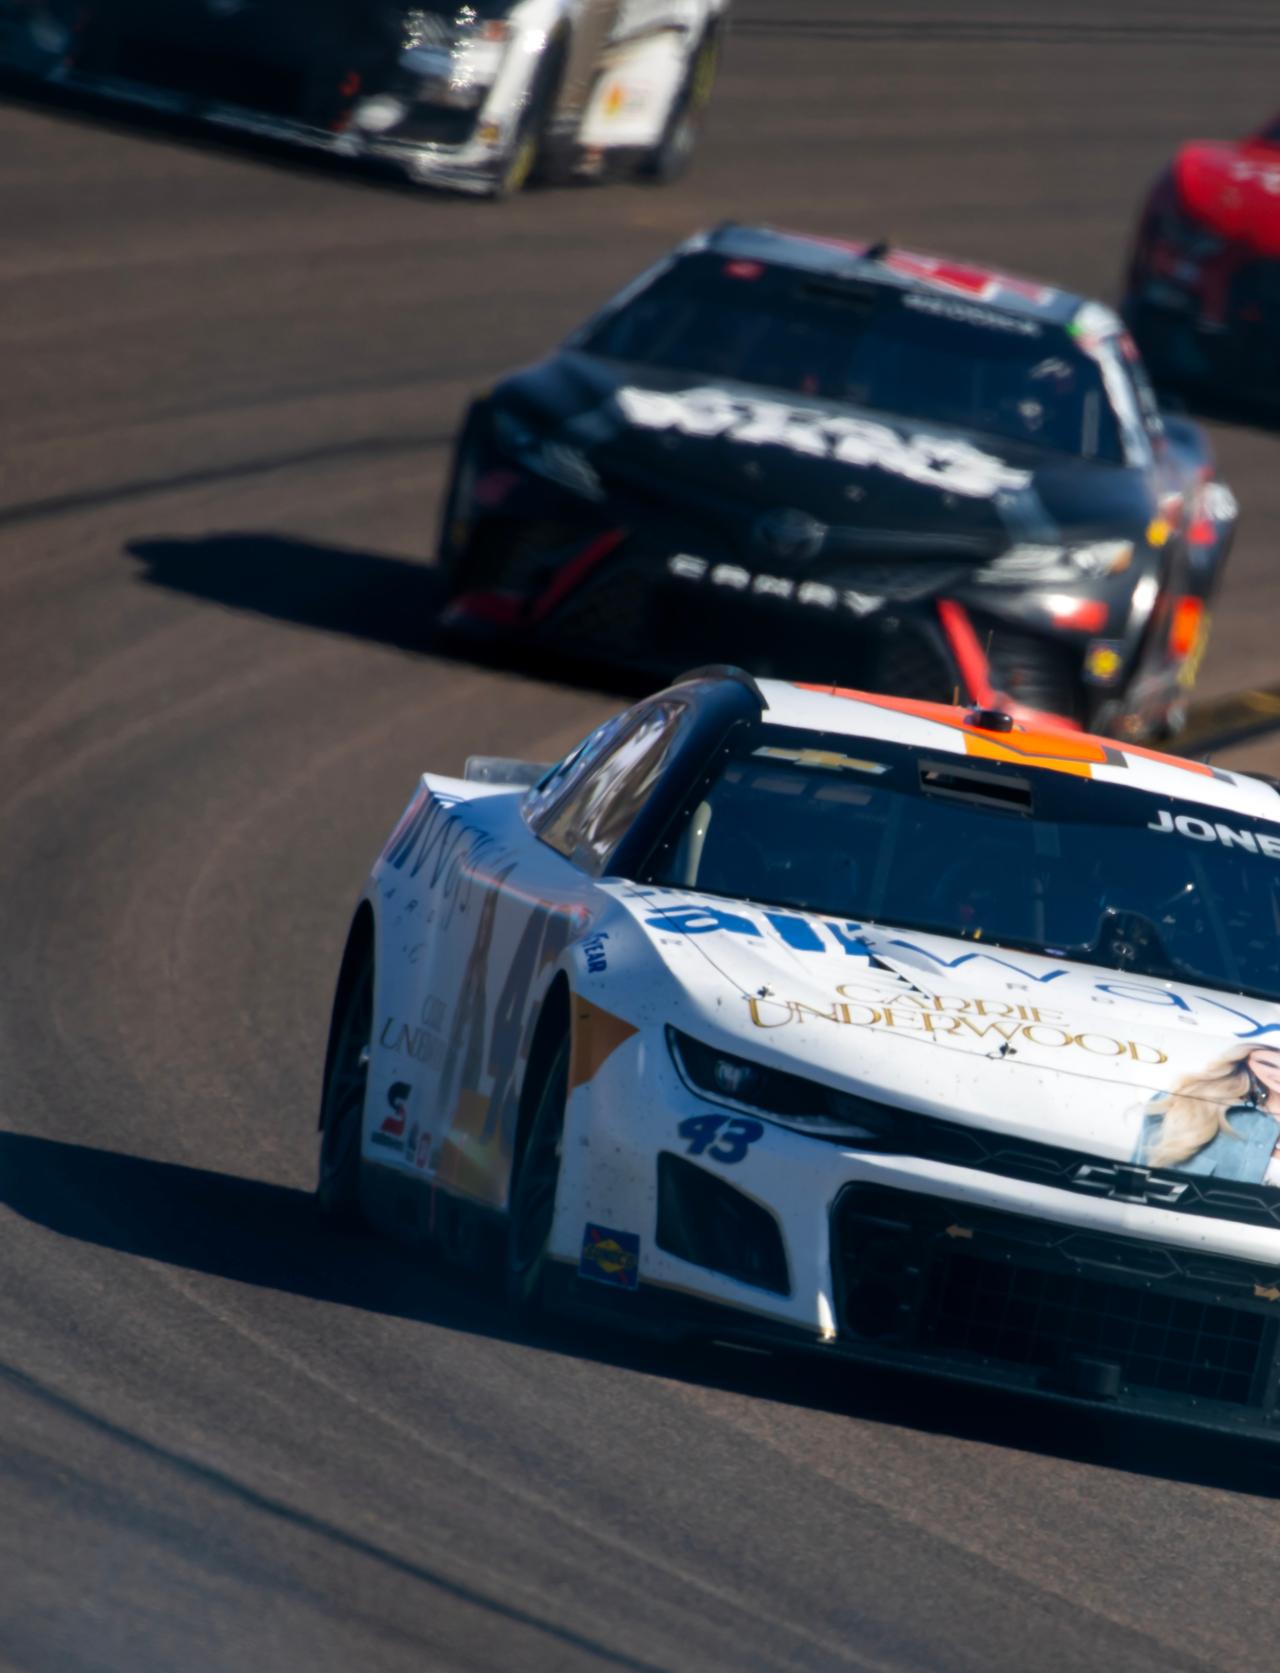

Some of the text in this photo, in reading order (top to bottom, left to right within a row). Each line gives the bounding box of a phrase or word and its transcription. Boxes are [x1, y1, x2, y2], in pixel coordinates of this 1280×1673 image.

[748, 997, 1169, 1065] UNDERWOOD
[835, 983, 1070, 1028] CARRIE
[677, 1113, 764, 1165] 43
